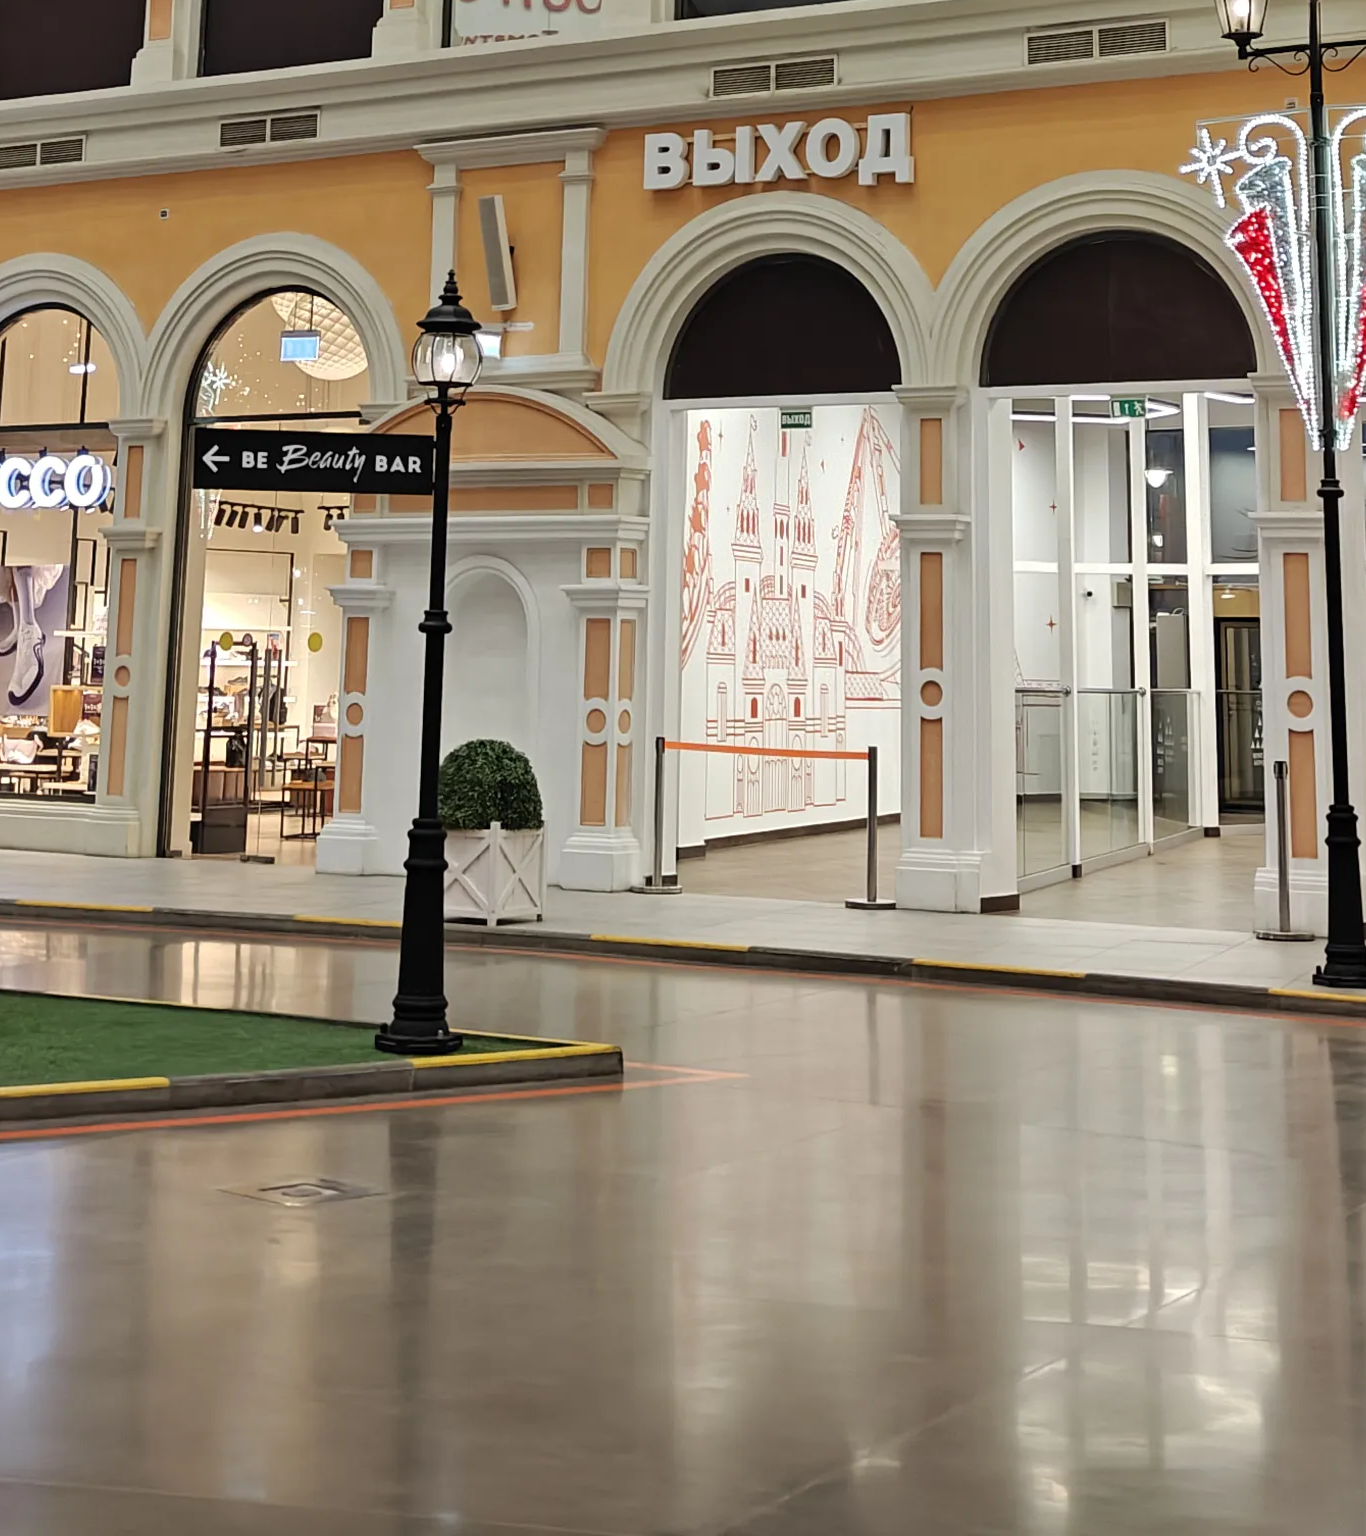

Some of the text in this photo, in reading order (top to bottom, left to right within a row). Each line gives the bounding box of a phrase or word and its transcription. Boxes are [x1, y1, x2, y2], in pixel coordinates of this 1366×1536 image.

[643, 112, 915, 191] ВЫХОД
[781, 414, 811, 426] ВЫХОД
[241, 444, 422, 483] BE Beauty BAR
